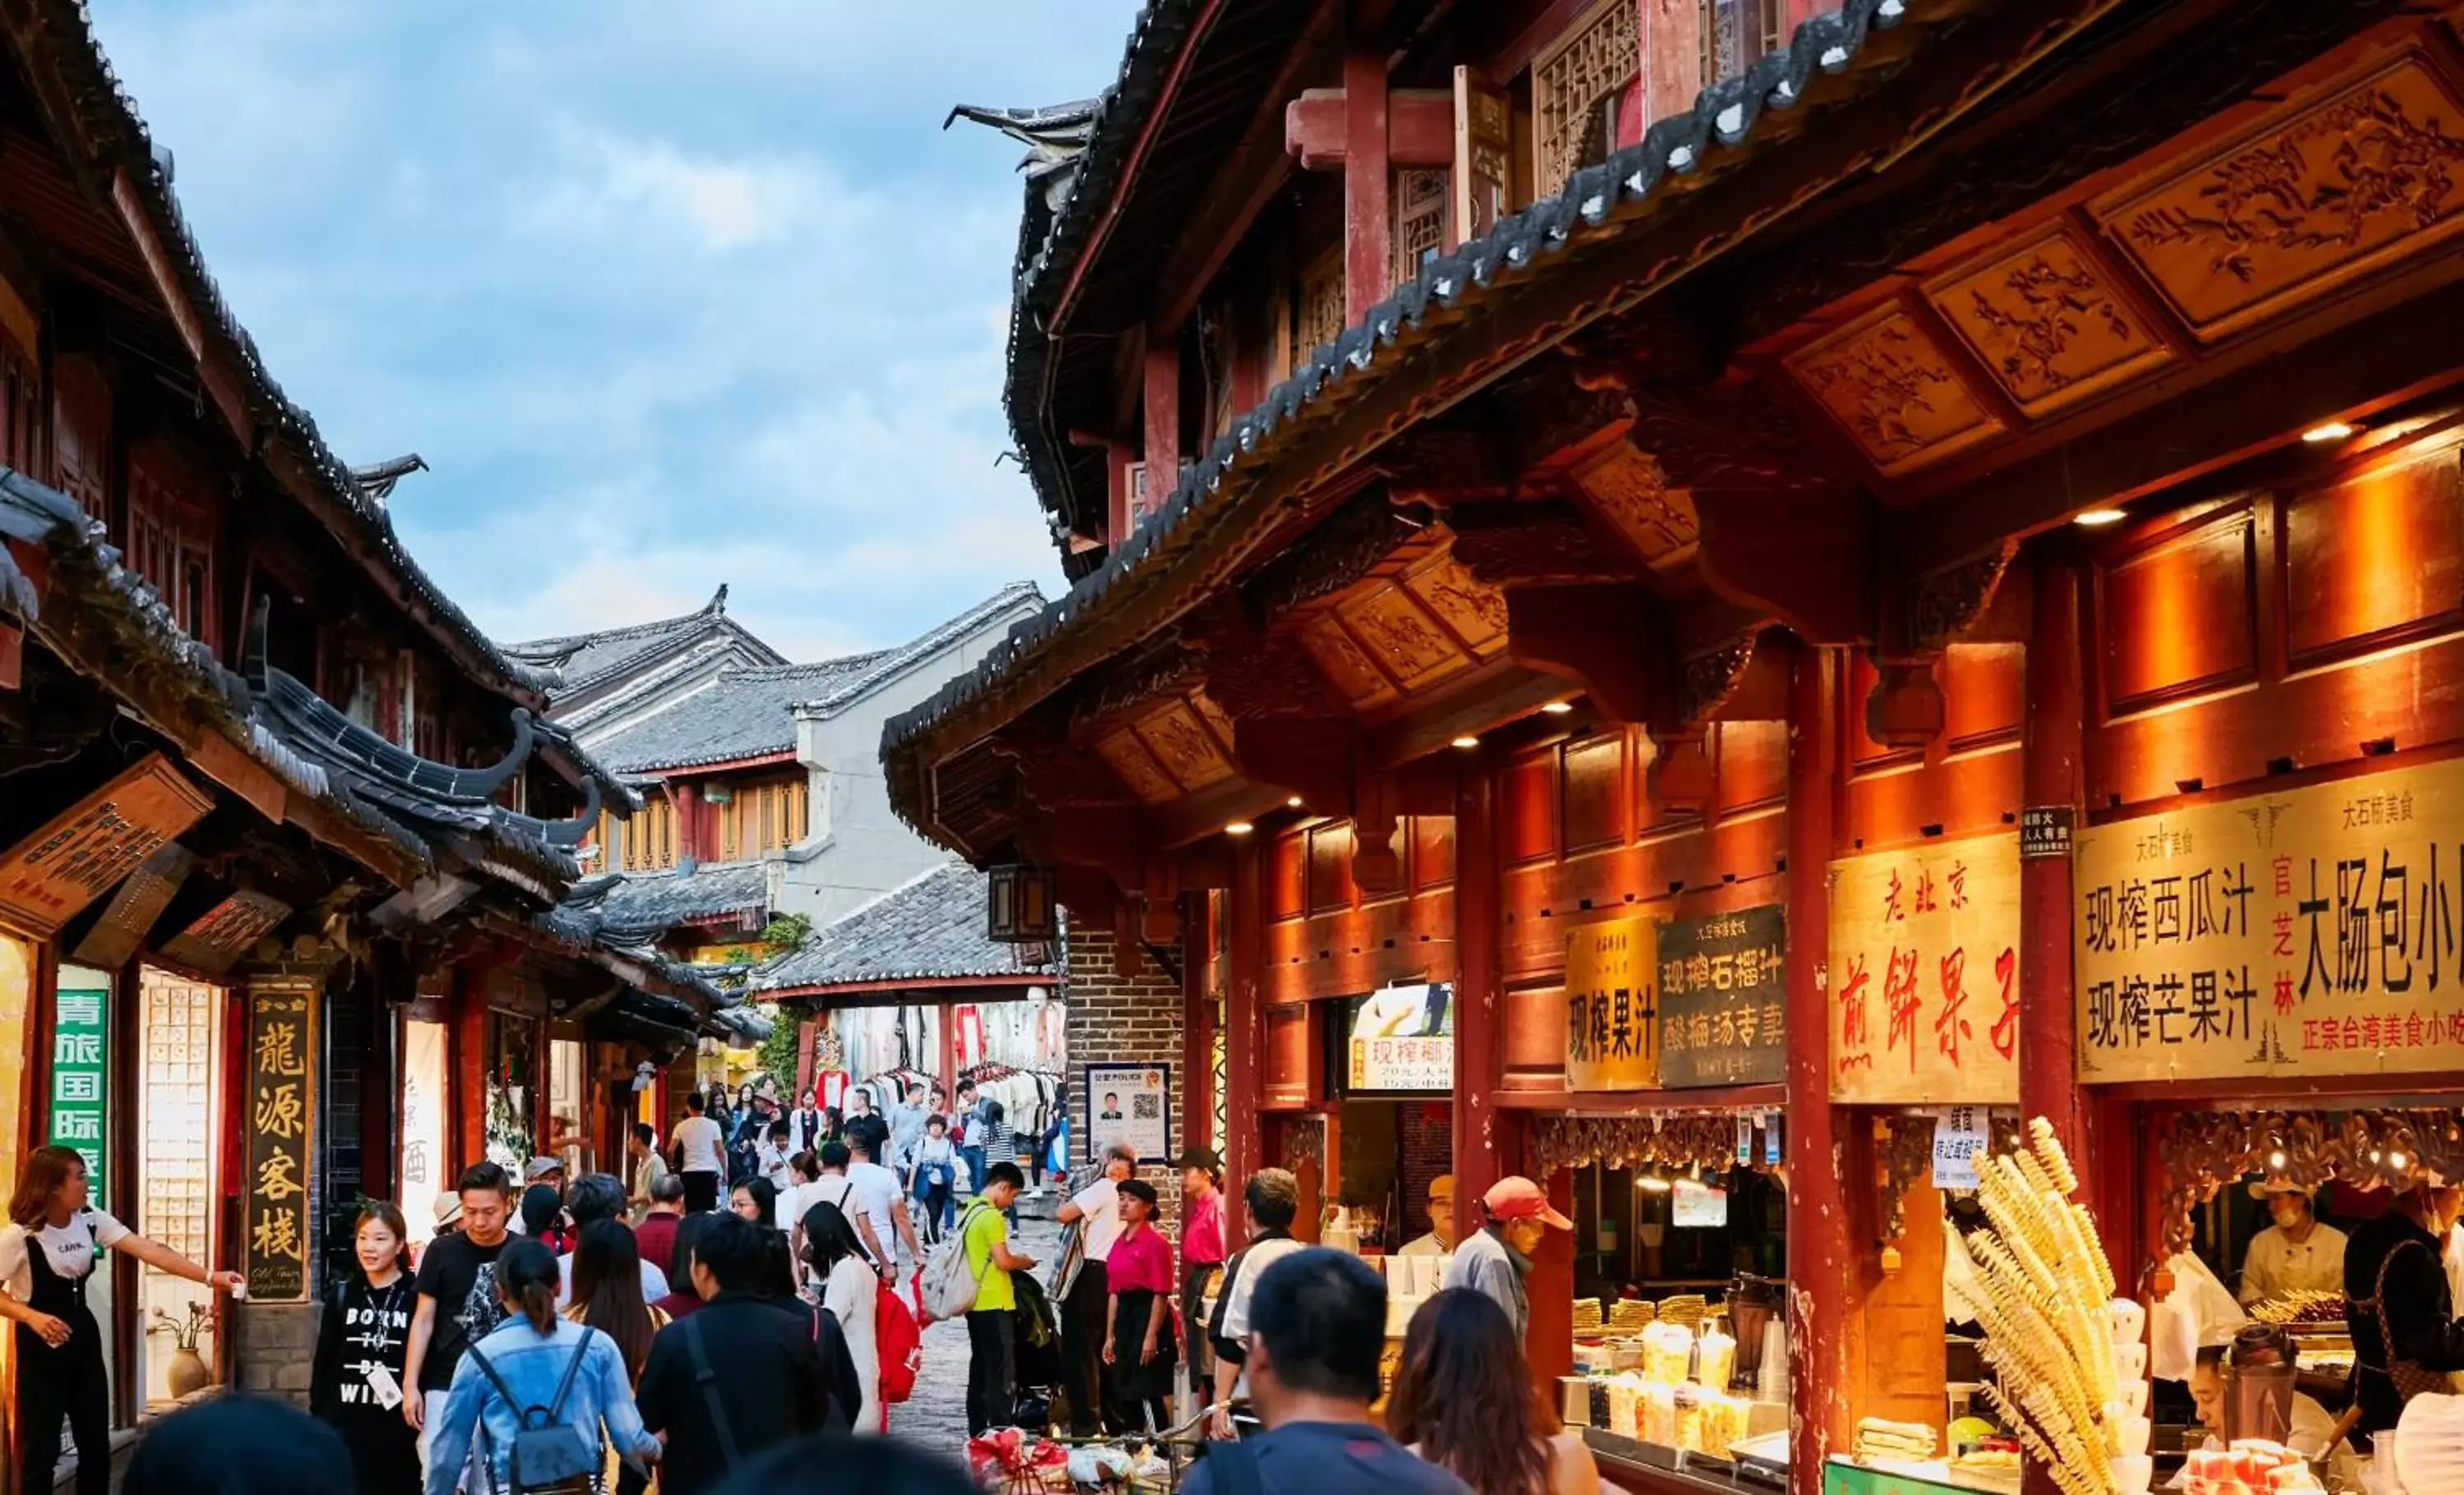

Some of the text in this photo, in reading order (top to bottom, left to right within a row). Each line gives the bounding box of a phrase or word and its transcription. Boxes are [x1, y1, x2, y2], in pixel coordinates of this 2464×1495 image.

[1884, 860, 1968, 922] 老北京
[2085, 862, 2255, 952] 现榨西瓜汁
[2298, 842, 2464, 1002] 大肠包小
[1662, 944, 1783, 995] 现榨石榴汁
[1569, 984, 1656, 1063] 现榨果汁
[1663, 1003, 1785, 1052] 酸梅汤专卖
[2087, 965, 2258, 1049] 现榨芒果汁
[2302, 1008, 2464, 1051] 正宗台湾美食小吃
[346, 1308, 407, 1327] BORN
